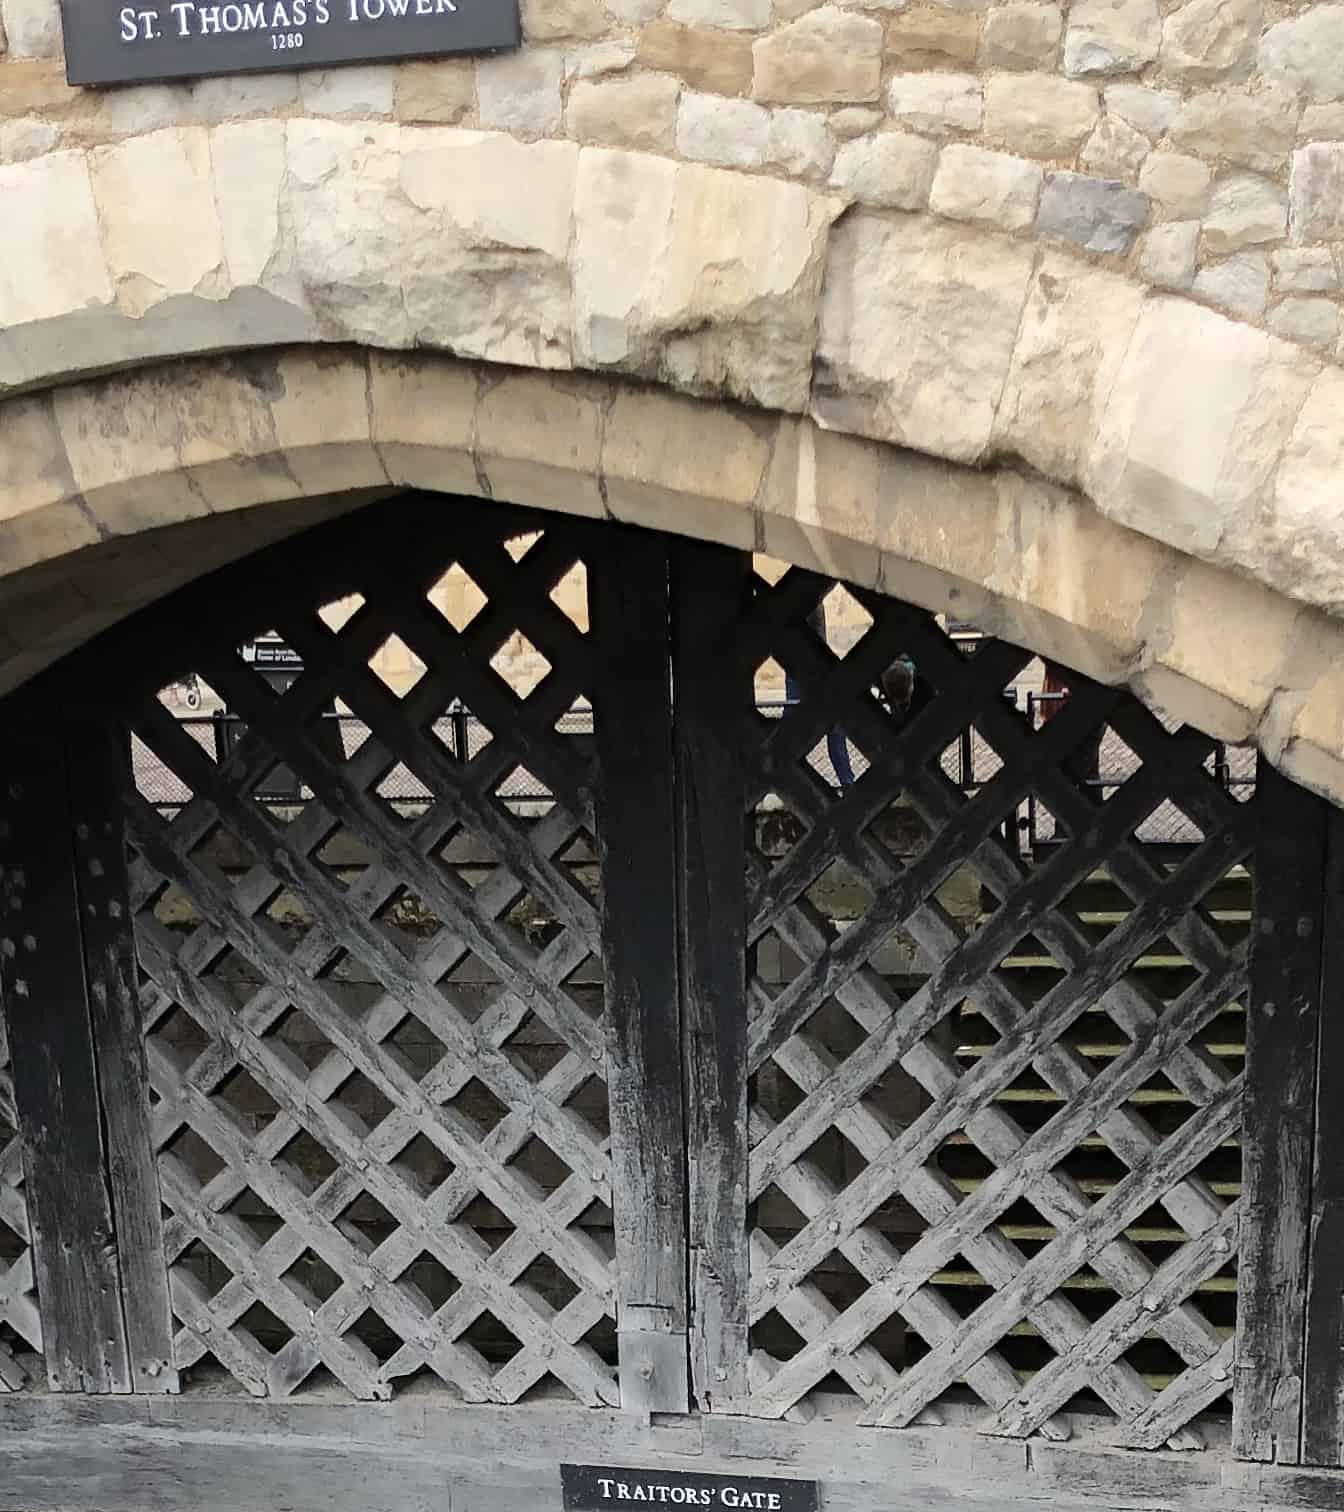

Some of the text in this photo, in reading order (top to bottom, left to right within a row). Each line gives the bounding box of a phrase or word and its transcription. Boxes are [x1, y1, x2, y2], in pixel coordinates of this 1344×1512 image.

[170, 0, 331, 36] THOMAS'S
[271, 32, 305, 50] 1280
[596, 1478, 781, 1510] TRAITORS' GATE
